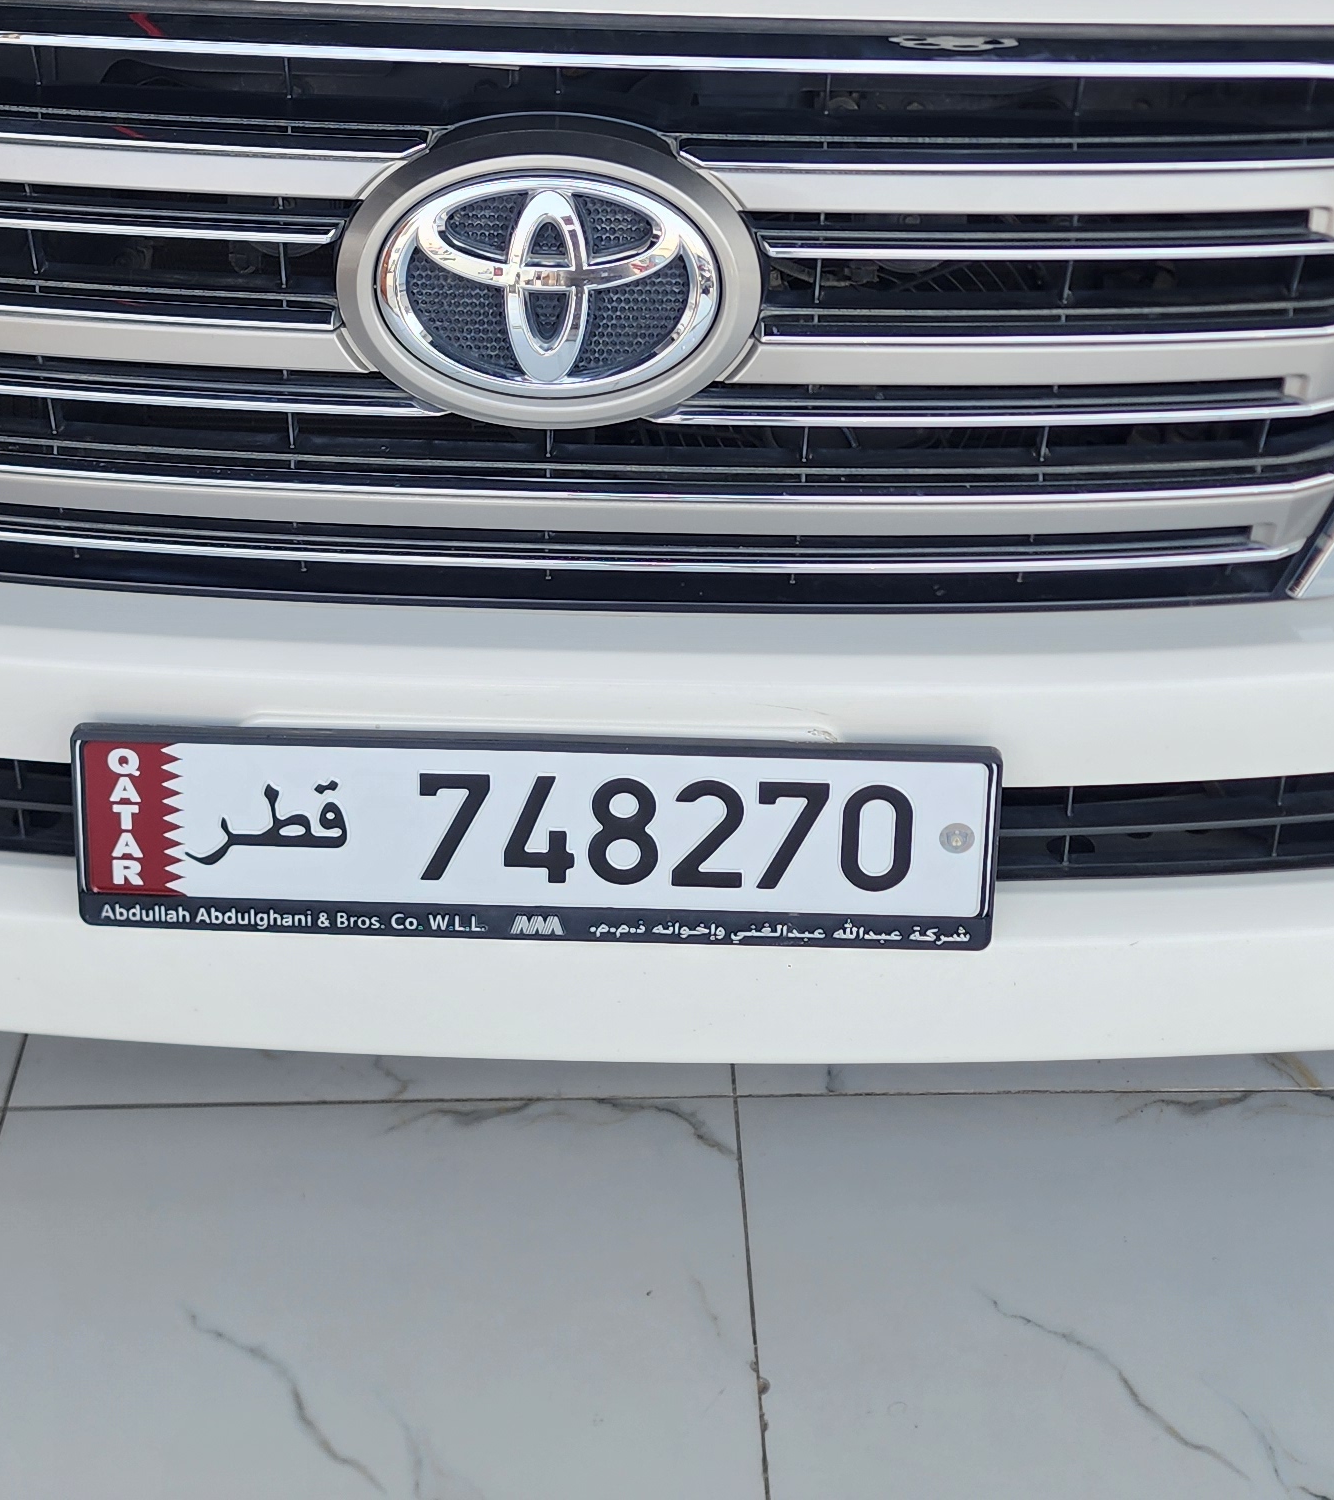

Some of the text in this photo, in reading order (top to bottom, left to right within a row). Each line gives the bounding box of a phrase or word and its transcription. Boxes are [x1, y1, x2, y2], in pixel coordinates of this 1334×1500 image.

[107, 748, 145, 886] QATAR
[184, 779, 348, 866] قطر
[418, 772, 914, 893] 748270
[100, 904, 191, 924] Abdullah
[195, 906, 313, 929] Abdulghani
[317, 912, 331, 928] &
[336, 911, 386, 930] Bros.
[390, 913, 424, 930] Co.
[651, 921, 726, 941] وإخوانه
[730, 922, 826, 943] عبدالغني
[832, 919, 903, 943] عبدالله
[908, 924, 971, 945] شركة
